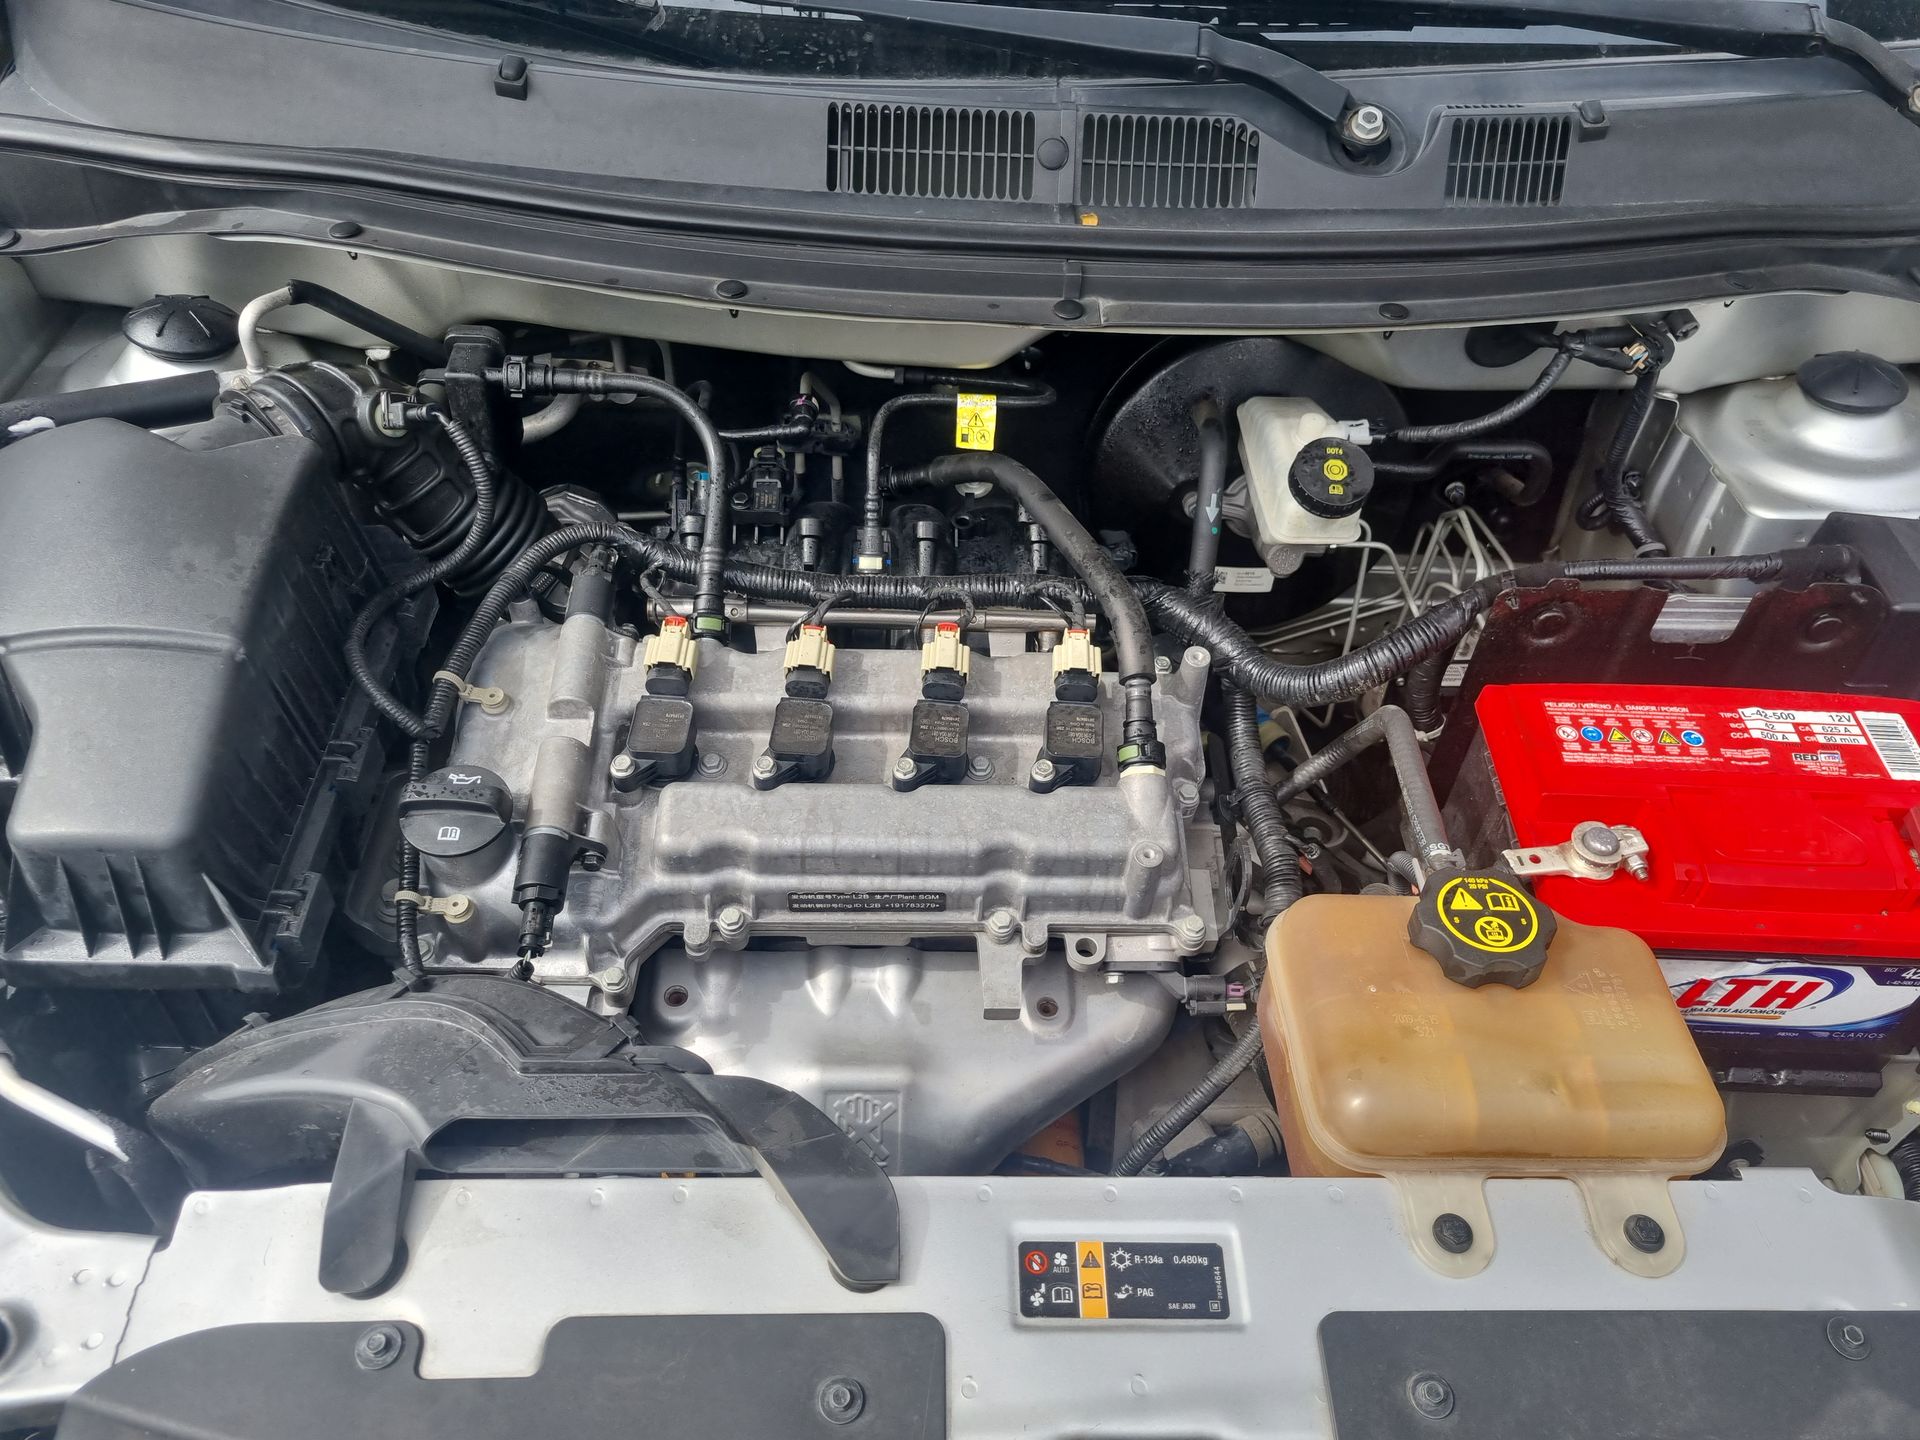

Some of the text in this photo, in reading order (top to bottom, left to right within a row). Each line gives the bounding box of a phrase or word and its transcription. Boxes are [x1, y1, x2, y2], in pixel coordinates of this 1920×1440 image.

[1741, 709, 1796, 721] L-42-500
[1829, 713, 1852, 723] 12V
[1729, 722, 1777, 731] BCI 42
[1821, 725, 1842, 734] 625
[1843, 726, 1852, 734] A
[934, 736, 959, 744] BOSCH
[1760, 731, 1779, 741] 500
[1781, 733, 1790, 741] A
[1823, 735, 1838, 744] 90
[1839, 735, 1860, 745] min
[1793, 753, 1819, 762] RED
[1675, 977, 1824, 1010] LTH
[1831, 1031, 1885, 1039] CLARIOS
[1134, 1255, 1208, 1265] R-134a 0.480kg
[1137, 1288, 1154, 1297] PAG
